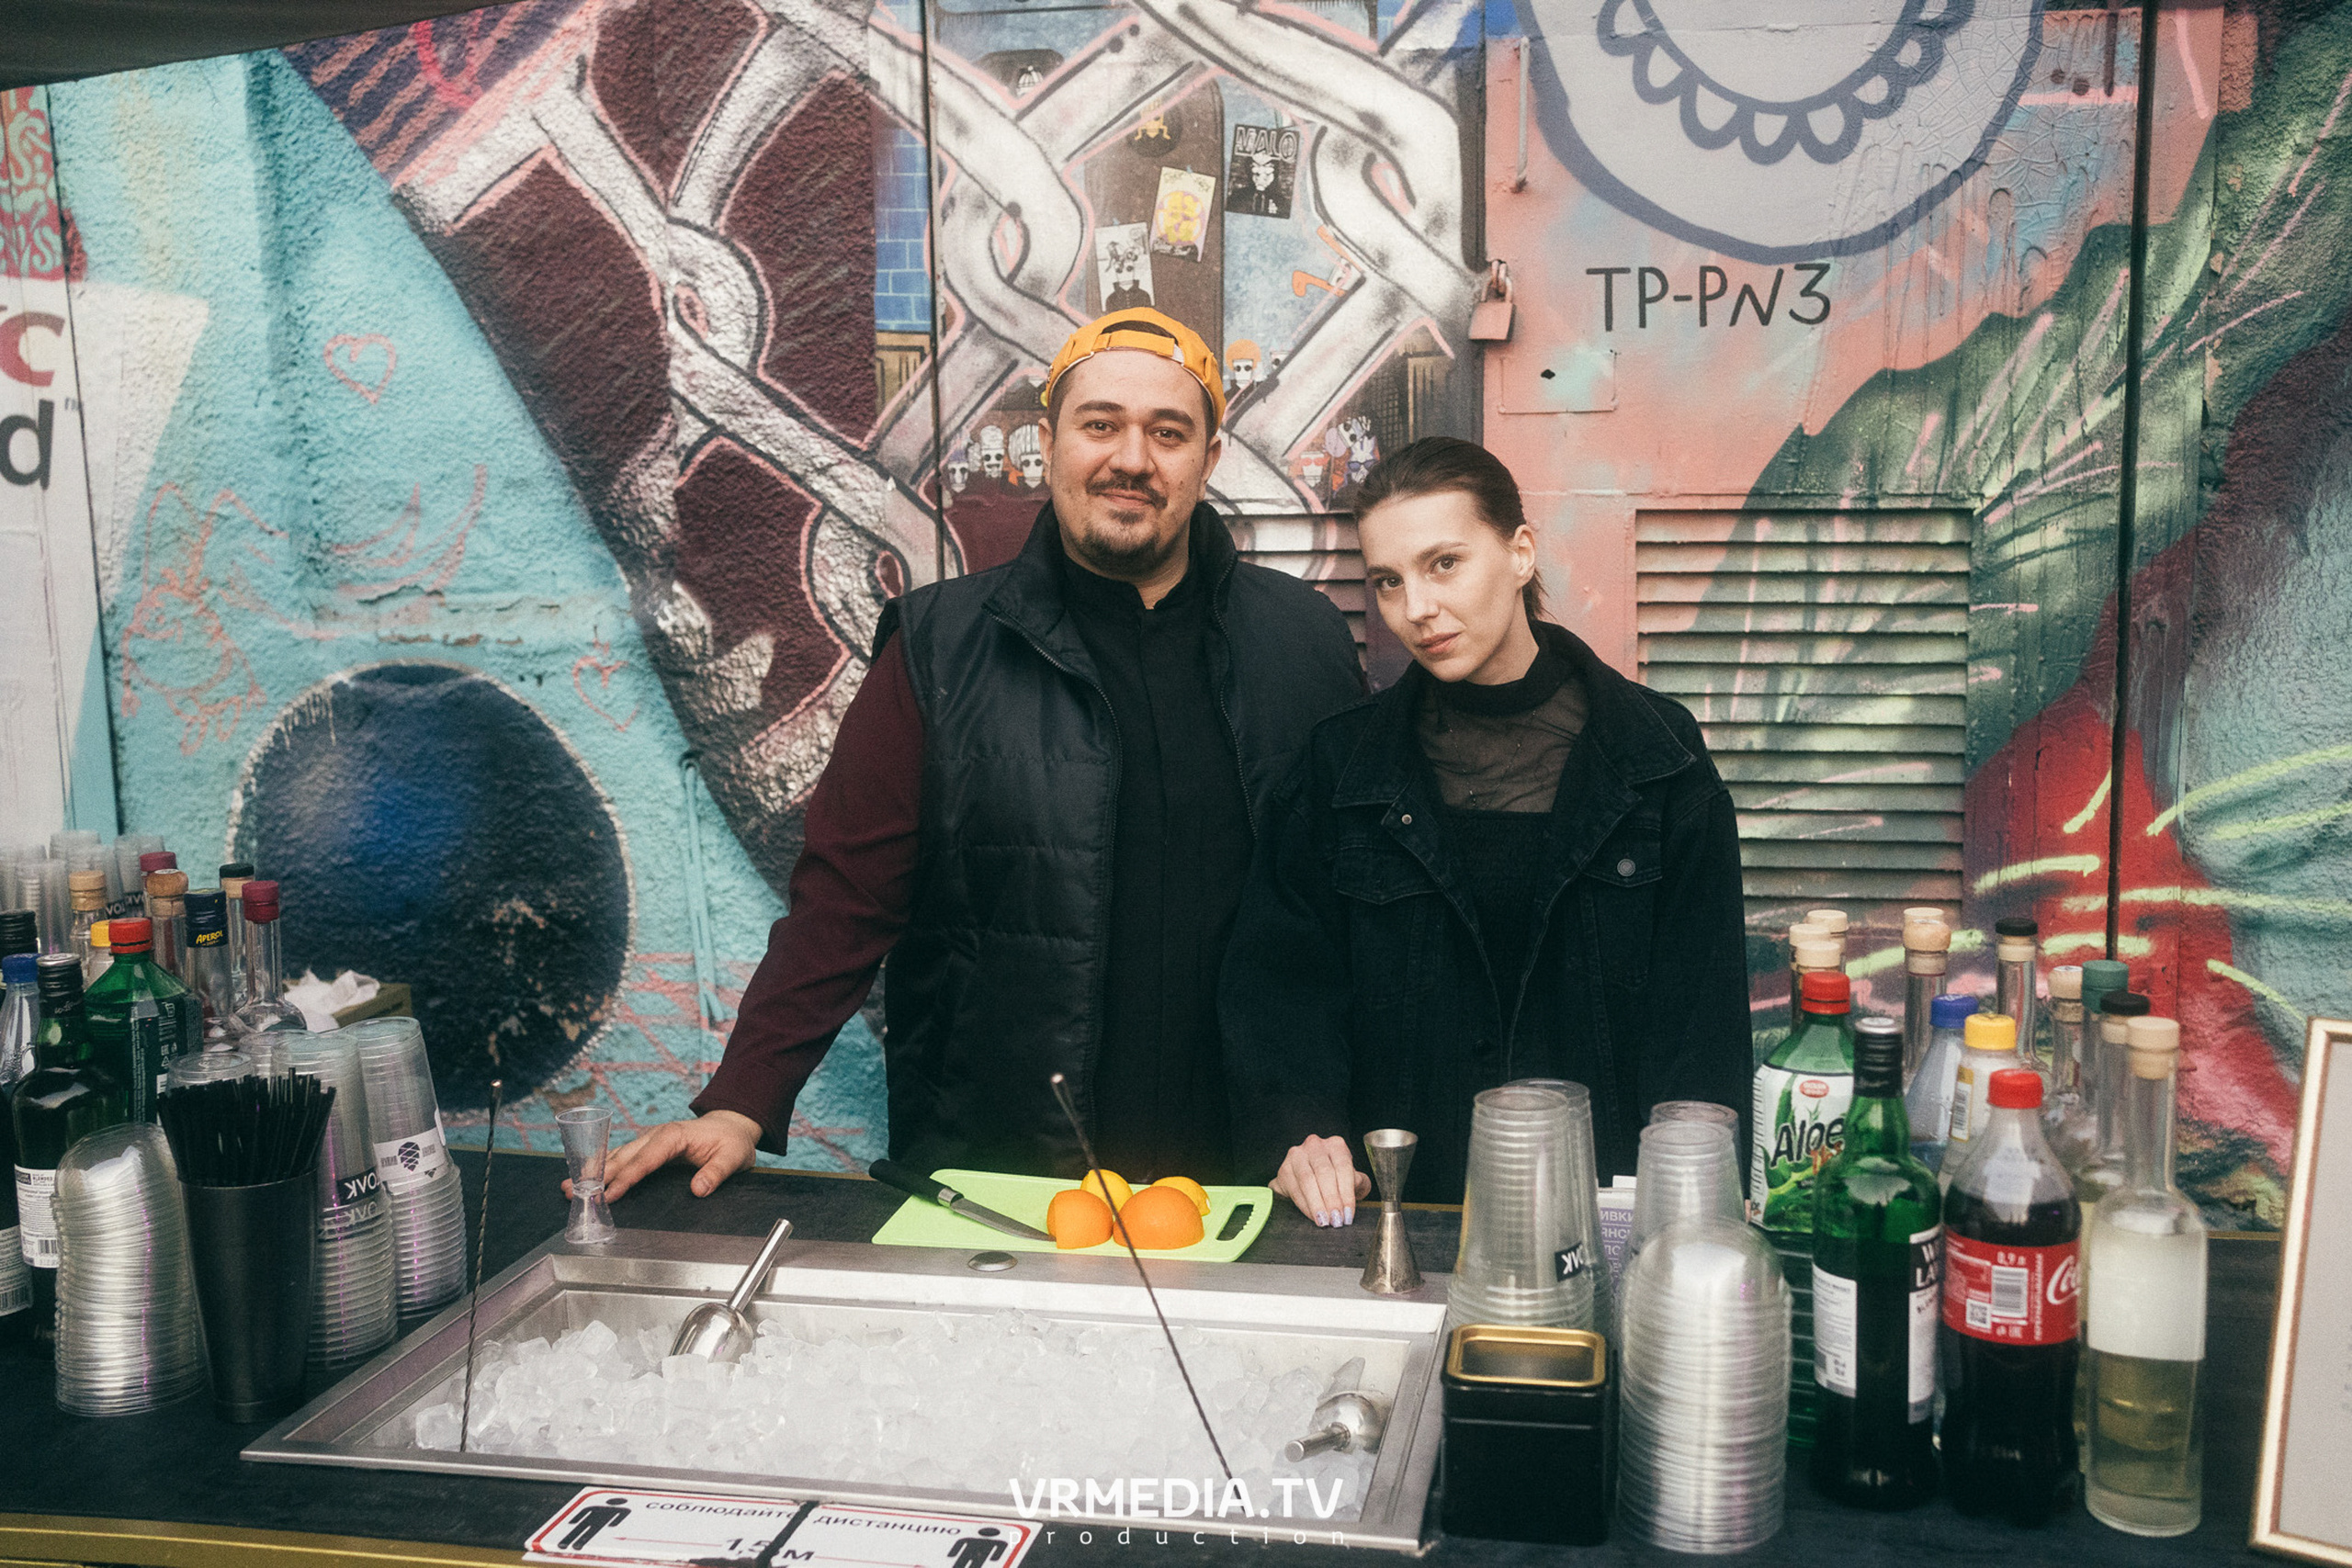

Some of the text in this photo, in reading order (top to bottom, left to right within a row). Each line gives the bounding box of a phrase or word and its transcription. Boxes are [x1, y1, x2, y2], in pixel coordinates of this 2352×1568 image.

[1234, 127, 1298, 164] MALO
[196, 930, 223, 945] APEROL
[1770, 1117, 1845, 1168] Aloe
[813, 1515, 961, 1535] дистанцию
